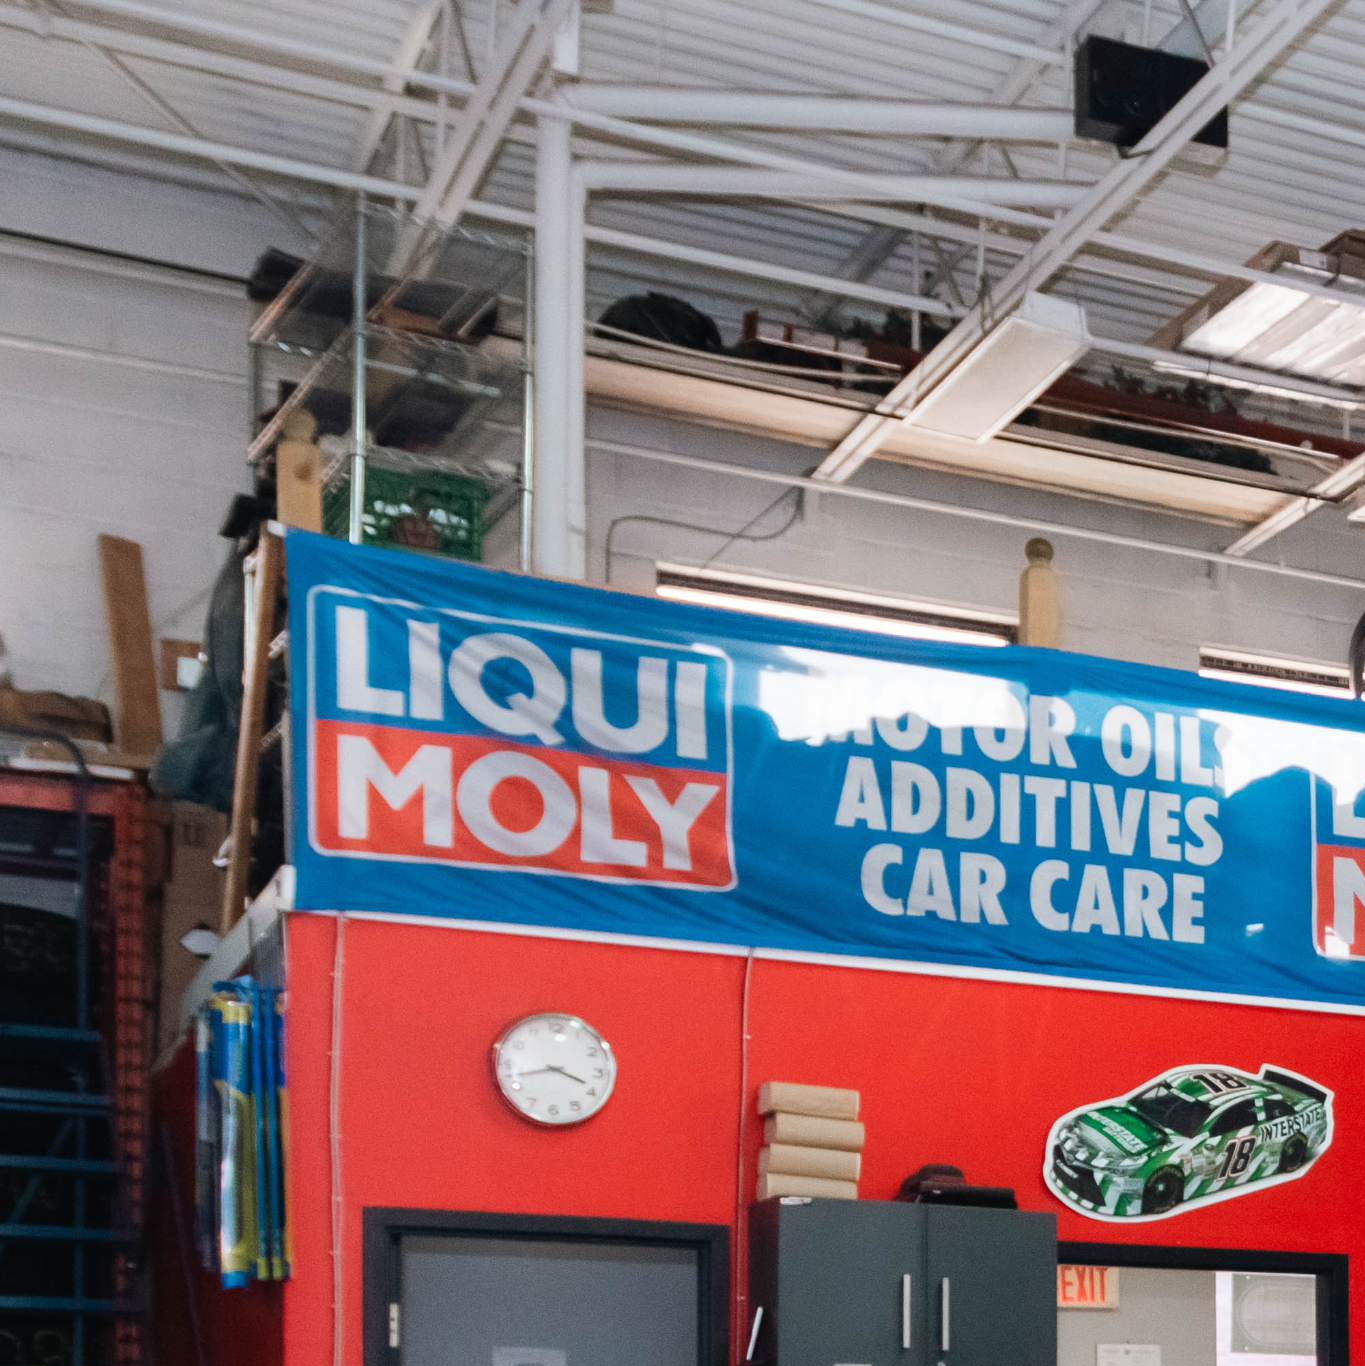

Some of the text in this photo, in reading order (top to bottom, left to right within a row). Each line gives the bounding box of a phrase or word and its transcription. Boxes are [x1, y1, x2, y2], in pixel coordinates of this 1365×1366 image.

[335, 606, 708, 746] LIQUI
[336, 735, 721, 872] MOLY
[834, 756, 1224, 866] ADDITIVES
[861, 843, 1206, 944] CAR CARE
[1190, 1070, 1250, 1096] 18
[1215, 1136, 1257, 1182] 18
[1259, 1107, 1322, 1143] INTERSTATE
[1060, 1264, 1108, 1302] EXIT
